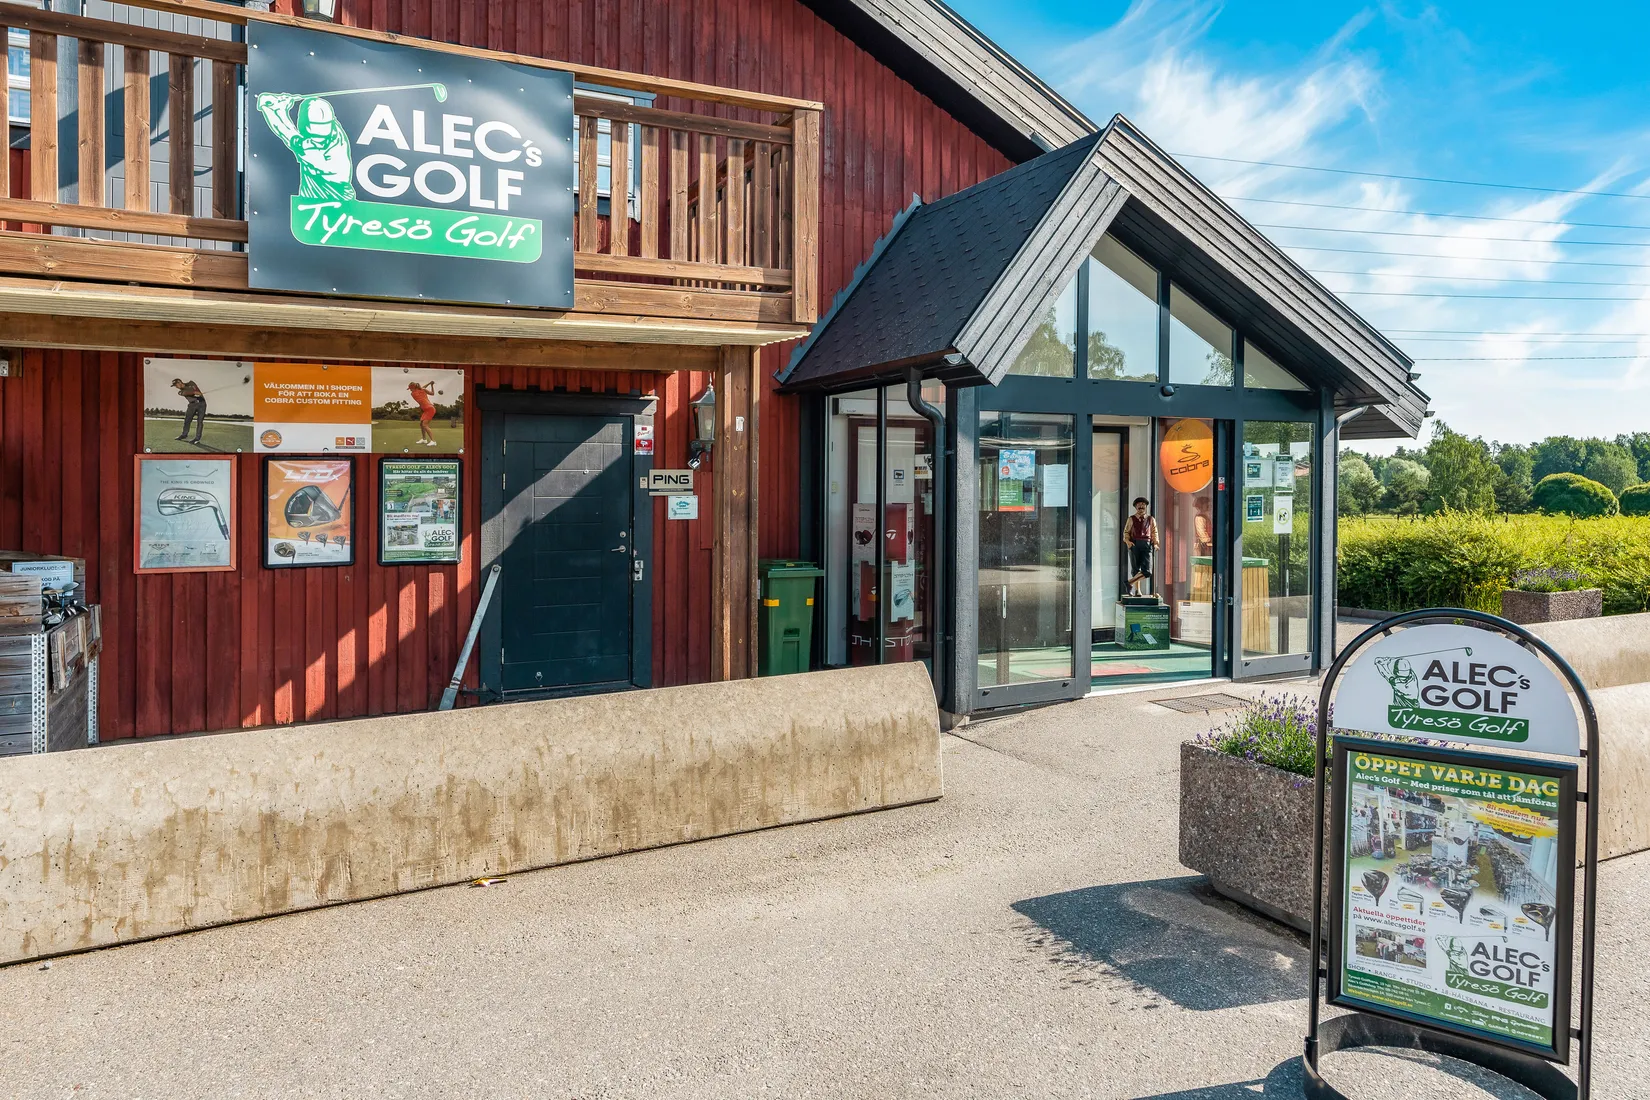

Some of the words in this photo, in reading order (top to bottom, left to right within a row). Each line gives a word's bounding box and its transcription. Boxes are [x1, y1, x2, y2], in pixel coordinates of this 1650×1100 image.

[356, 104, 543, 168] ALEC's
[356, 154, 524, 211] GOLF
[298, 202, 433, 244] Tyresö
[445, 216, 536, 249] Golf
[264, 382, 315, 391] VÄLKOMMEN
[330, 384, 363, 392] SHOPEN
[296, 390, 313, 398] ATT
[653, 474, 690, 485] PING
[1170, 460, 1209, 476] cobra
[1421, 659, 1531, 690] ALEC's
[1420, 684, 1518, 714] GOLF
[1391, 708, 1462, 729] Tyresö
[1468, 716, 1525, 737] Golf
[1355, 752, 1425, 779] ÖPPET
[1430, 765, 1502, 789] VARJE
[1507, 776, 1559, 797] DAG
[1355, 772, 1380, 782] Alec's
[1382, 775, 1401, 785] Golf
[1410, 779, 1430, 790] Med
[1431, 783, 1460, 795] priser
[1461, 788, 1482, 797] som
[1482, 788, 1496, 799] tål
[1497, 792, 1512, 802] att
[1512, 795, 1557, 808] jämföras
[1498, 806, 1529, 818] medlem
[1353, 906, 1384, 918] Aktuella
[1363, 915, 1426, 933] www.alecsgolf.se
[1470, 941, 1551, 973] ALEC's
[1447, 973, 1500, 994] Tyresö
[1504, 987, 1546, 1003] Golf
[1469, 959, 1541, 988] GOLF
[1374, 970, 1397, 979] RANGE
[1406, 978, 1432, 990] STUDIO
[1499, 1006, 1546, 1024] RESTAURANG
